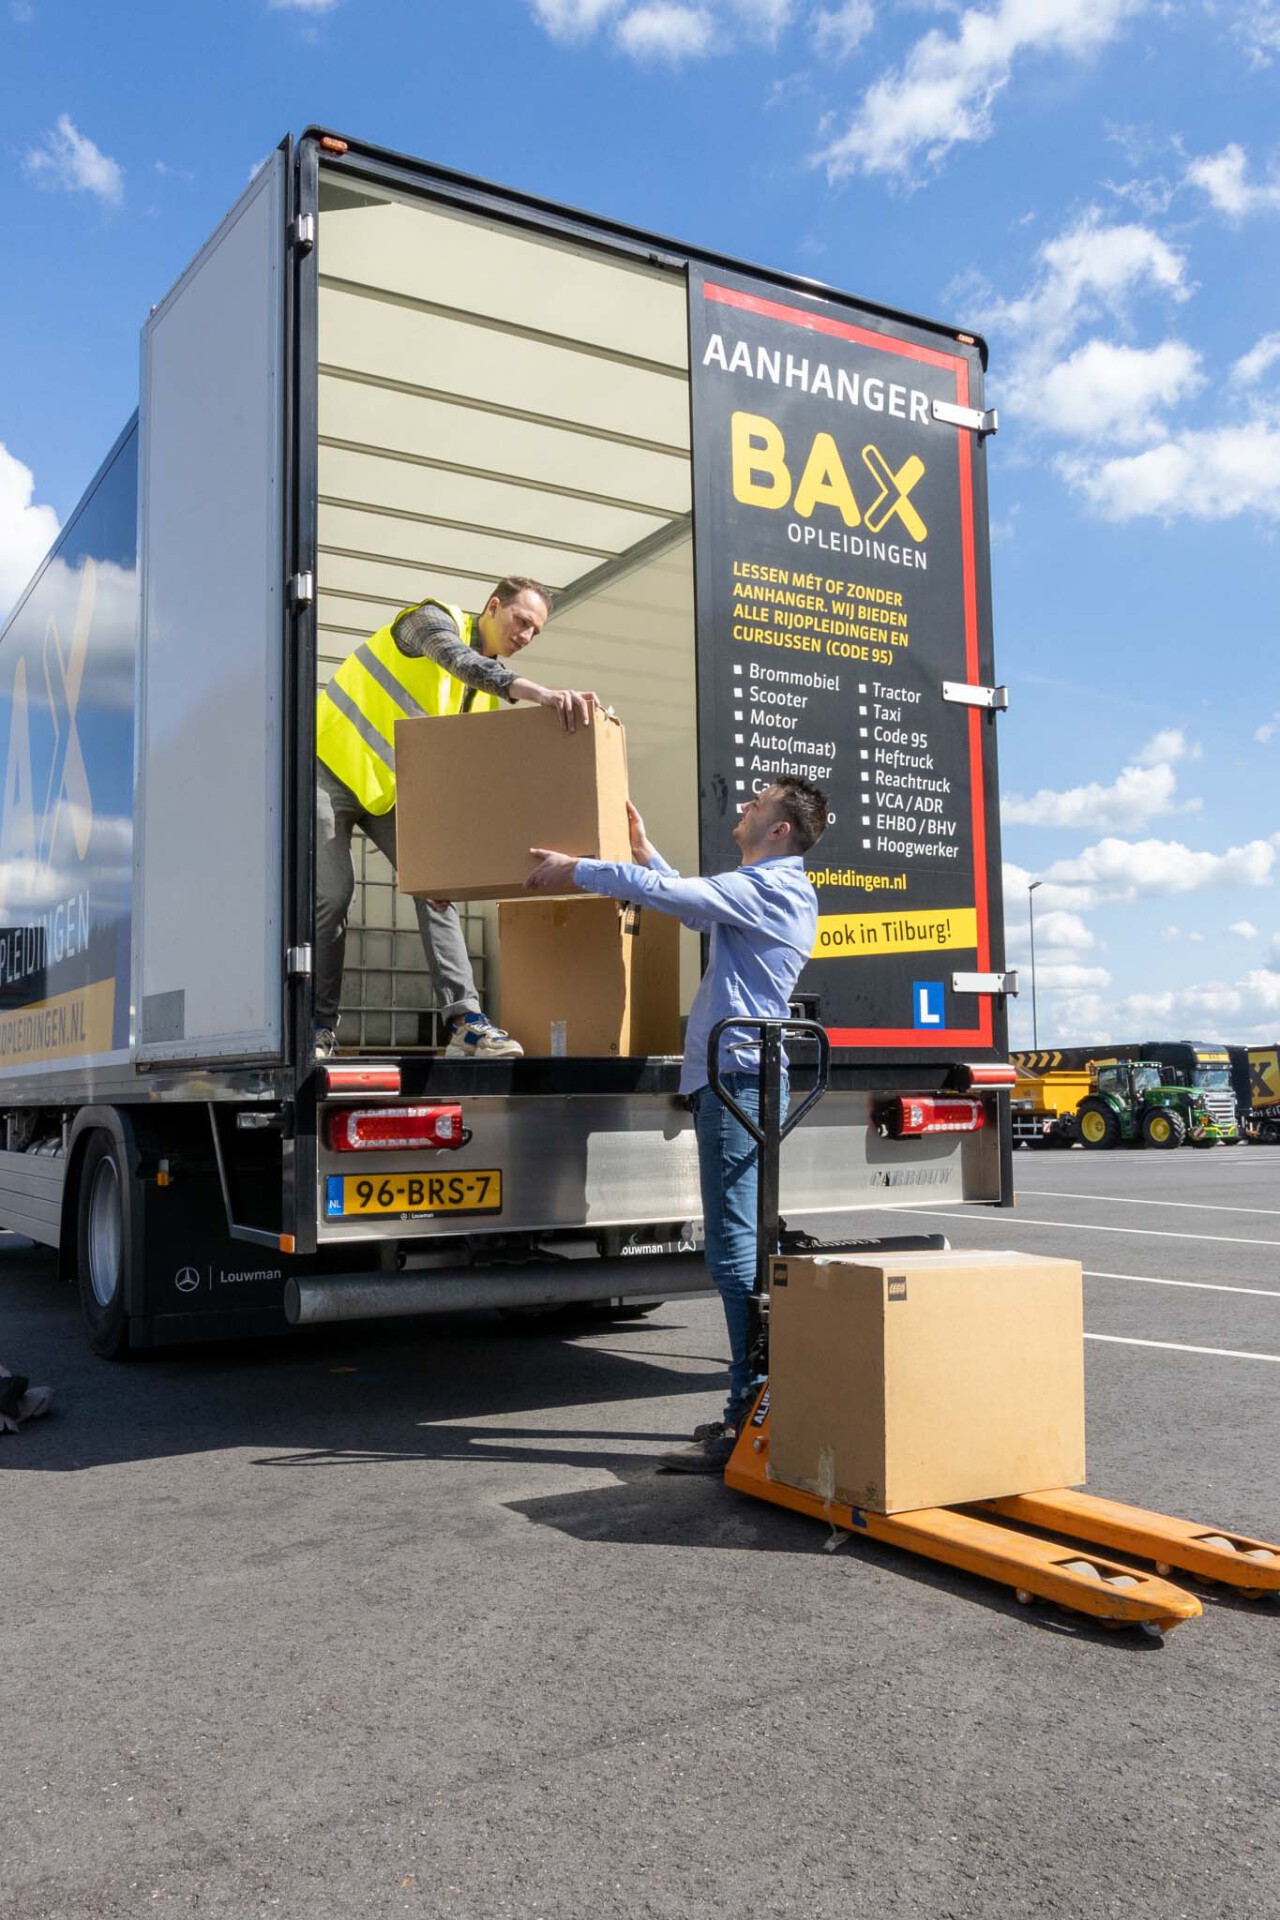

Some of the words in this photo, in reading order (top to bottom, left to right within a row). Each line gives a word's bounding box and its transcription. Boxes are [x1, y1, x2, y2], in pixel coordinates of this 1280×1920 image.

[702, 333, 930, 425] AANHANGER
[730, 410, 928, 543] BAX
[787, 522, 928, 570] OPLEIDINGEN
[733, 561, 789, 585] LESSEN
[792, 573, 822, 590] MÉT
[826, 580, 844, 595] OF
[846, 583, 903, 607] ZONDER
[733, 582, 829, 613] AANHANGER.
[832, 600, 855, 620] WIJ
[858, 605, 908, 627] BIEDEN
[733, 603, 769, 623] ALLE
[774, 609, 888, 644] RIJOPLEIDINGEN
[891, 632, 909, 647] EN
[733, 625, 821, 653] CURSUSSEN
[826, 639, 869, 662] (CODE
[871, 648, 894, 666] 95)
[750, 663, 840, 692] Brommobiel
[750, 686, 808, 708] Scooter
[873, 682, 921, 704] Tractor
[750, 709, 798, 730] Motor
[874, 704, 901, 723] Taxi
[750, 732, 837, 760] Auto(maat)
[874, 726, 908, 745] Code
[911, 732, 928, 748] 95
[750, 755, 832, 781] Aanhanger
[875, 748, 934, 770] Heftruck
[875, 770, 951, 794] Reachtruck
[876, 792, 904, 812] VCA
[914, 796, 943, 814] ADR
[876, 814, 917, 833] EHBO
[928, 818, 957, 837] BHV
[877, 836, 959, 859] Hoogwerker
[804, 867, 907, 892] opleidingen.nl
[820, 924, 856, 947] ook
[861, 923, 879, 944] in
[882, 918, 952, 944] Tilburg!
[919, 988, 941, 1023] L
[0, 1001, 86, 1056] OPLEIDINGEN.NL
[329, 1200, 342, 1209] NL
[356, 1176, 491, 1209] 96-BRS-7
[620, 1244, 664, 1256] ouwman
[220, 1268, 282, 1284] Louwman
